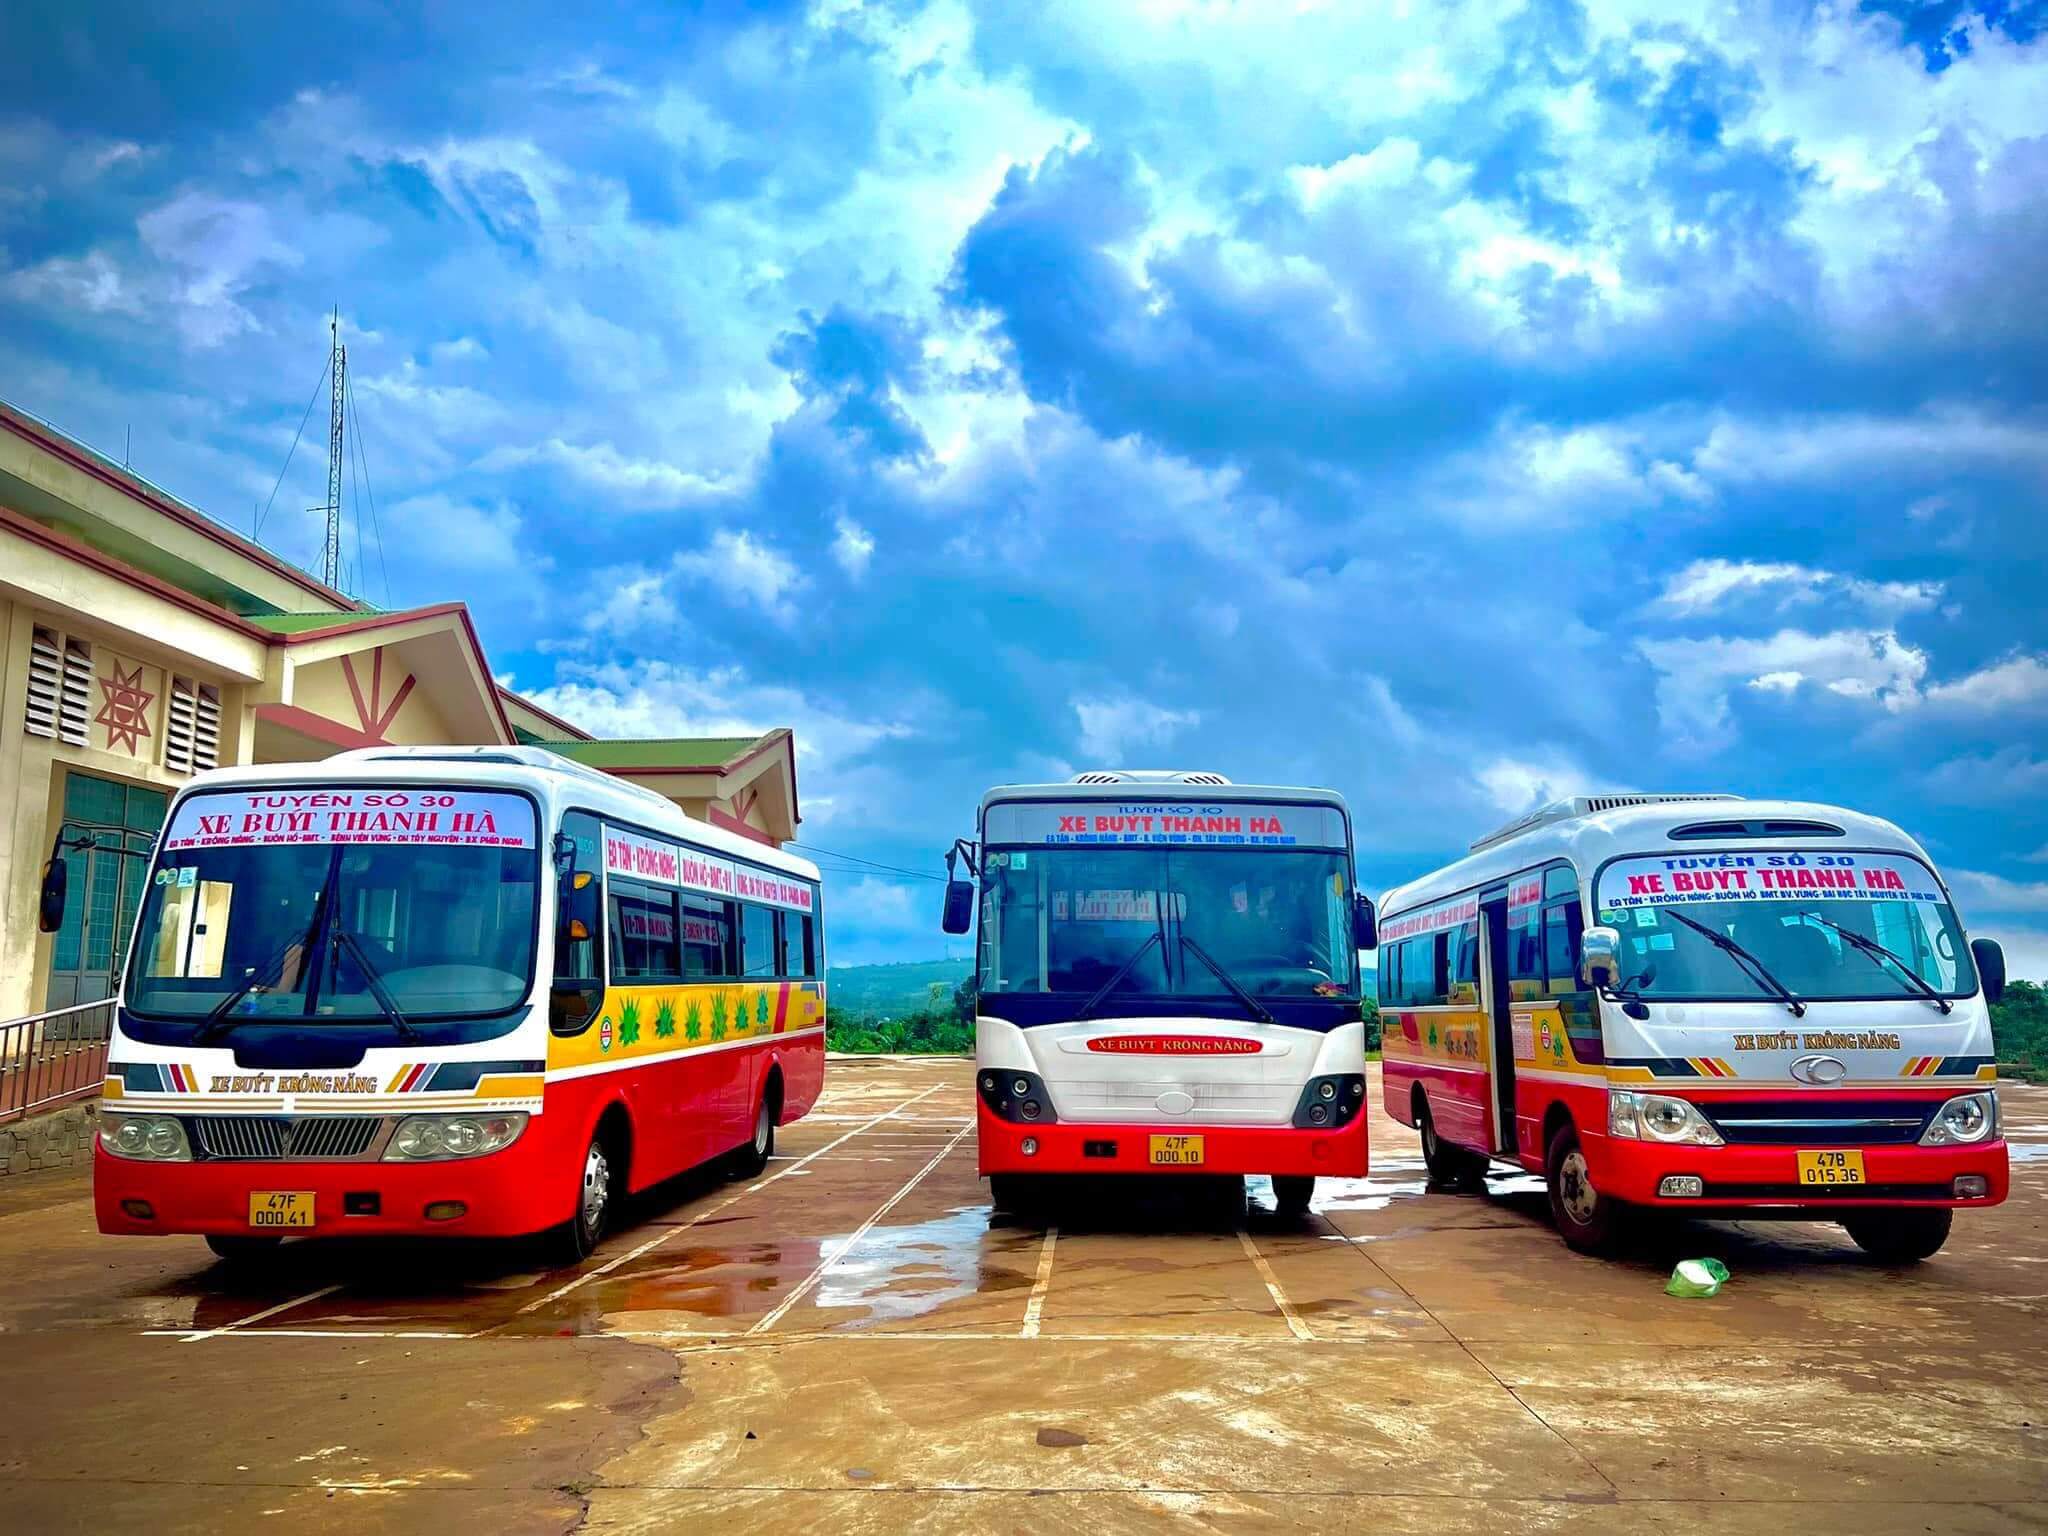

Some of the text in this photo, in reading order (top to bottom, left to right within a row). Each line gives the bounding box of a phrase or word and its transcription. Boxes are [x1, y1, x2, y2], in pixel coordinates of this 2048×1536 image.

[420, 796, 456, 807] 30
[194, 808, 497, 836] XE BUÝT THANH HÀ
[1058, 813, 1283, 833] XE BUÝT THANH HÀ
[1818, 856, 1855, 866] 30
[1627, 867, 1905, 894] XE BUÝT THANH HÀ
[1623, 896, 1643, 906] TÂN
[1650, 892, 1687, 904] KRÔNG
[1098, 1040, 1116, 1050] XE
[1732, 1029, 1901, 1051] XE BUÝT KRÔNG NĂNG
[208, 1071, 378, 1093] XE BUÝT KRÔNG NĂNG
[1165, 1136, 1189, 1149] 47F
[1155, 1150, 1199, 1163] 000.10
[1817, 1152, 1846, 1167] 47B
[1806, 1168, 1859, 1182] 015.36
[268, 1194, 297, 1209] 47F
[256, 1210, 306, 1225] 000.41
